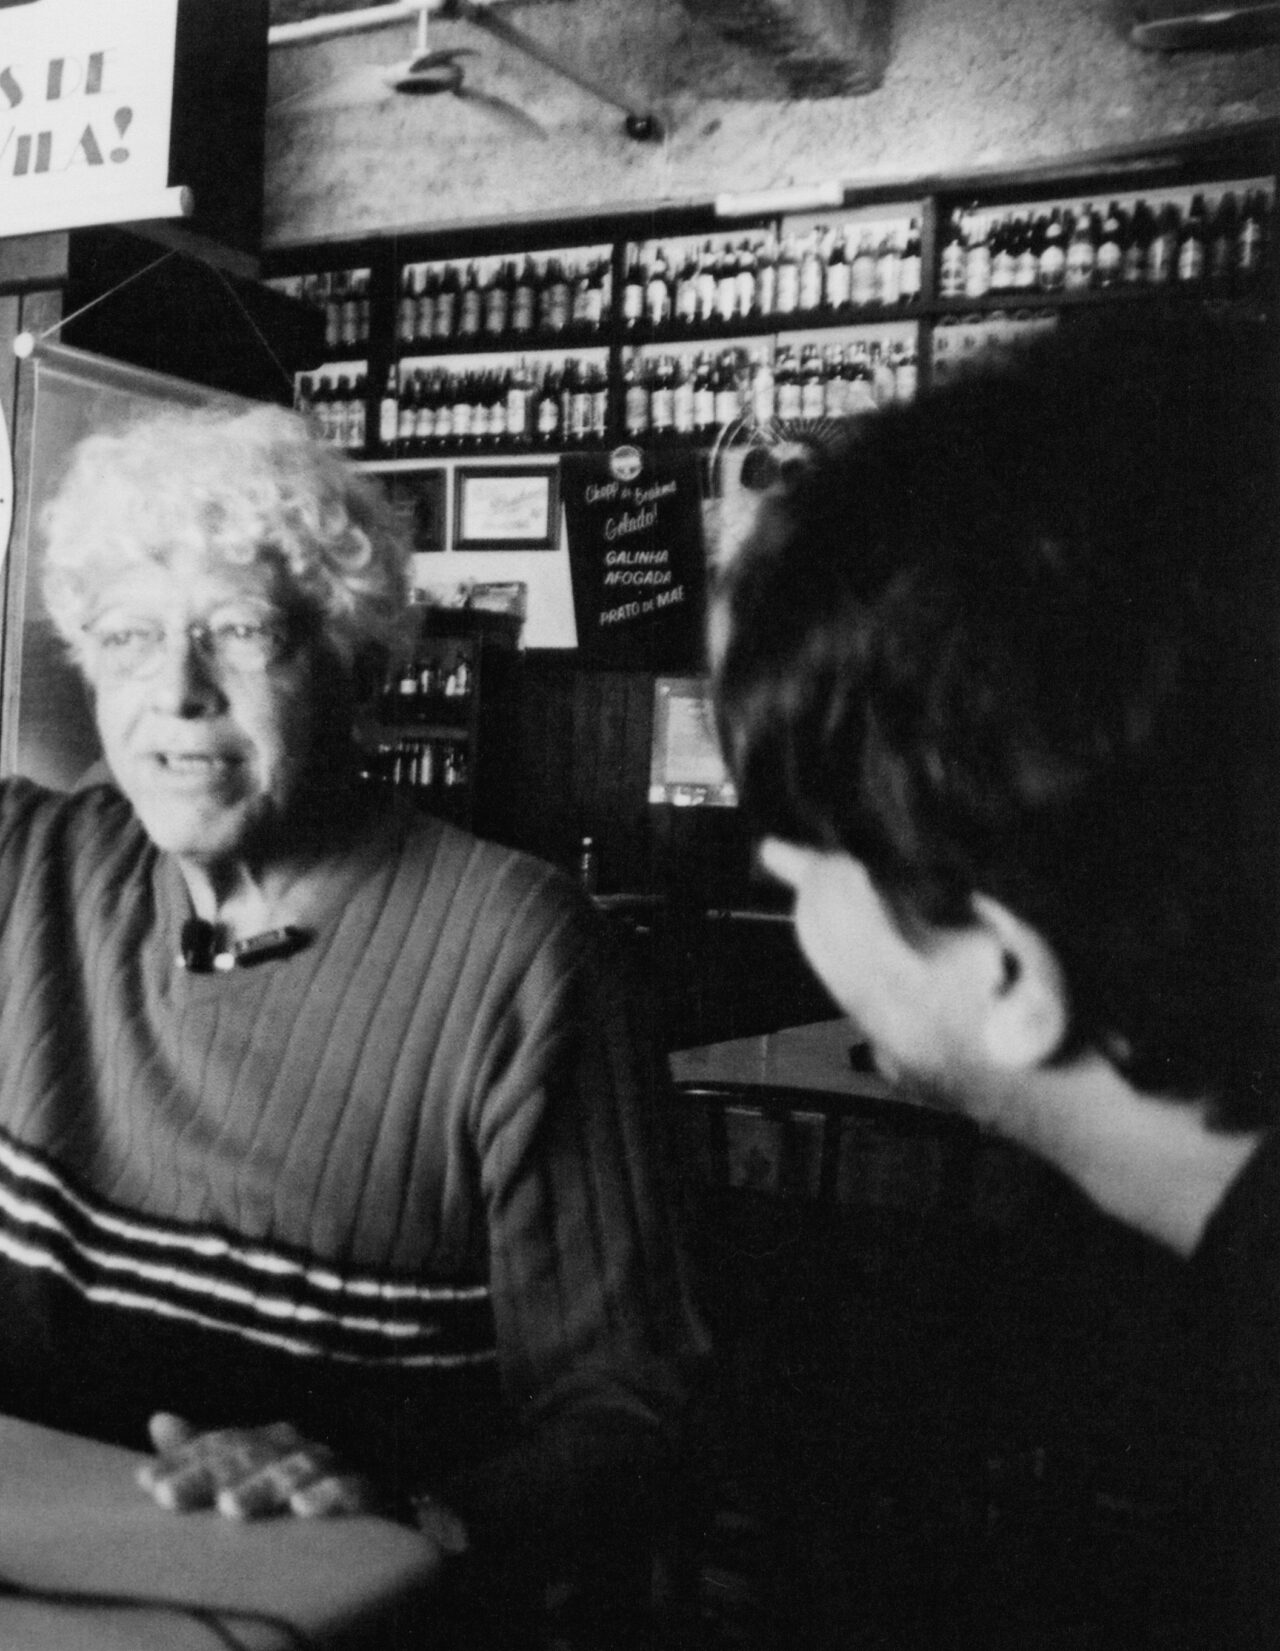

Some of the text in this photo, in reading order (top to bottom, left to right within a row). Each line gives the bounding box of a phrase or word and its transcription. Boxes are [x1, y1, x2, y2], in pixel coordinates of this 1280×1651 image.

[46, 47, 117, 101] DE
[605, 550, 669, 565] GALINHA
[604, 570, 672, 585] AFOGADA
[599, 601, 640, 625] PRATO
